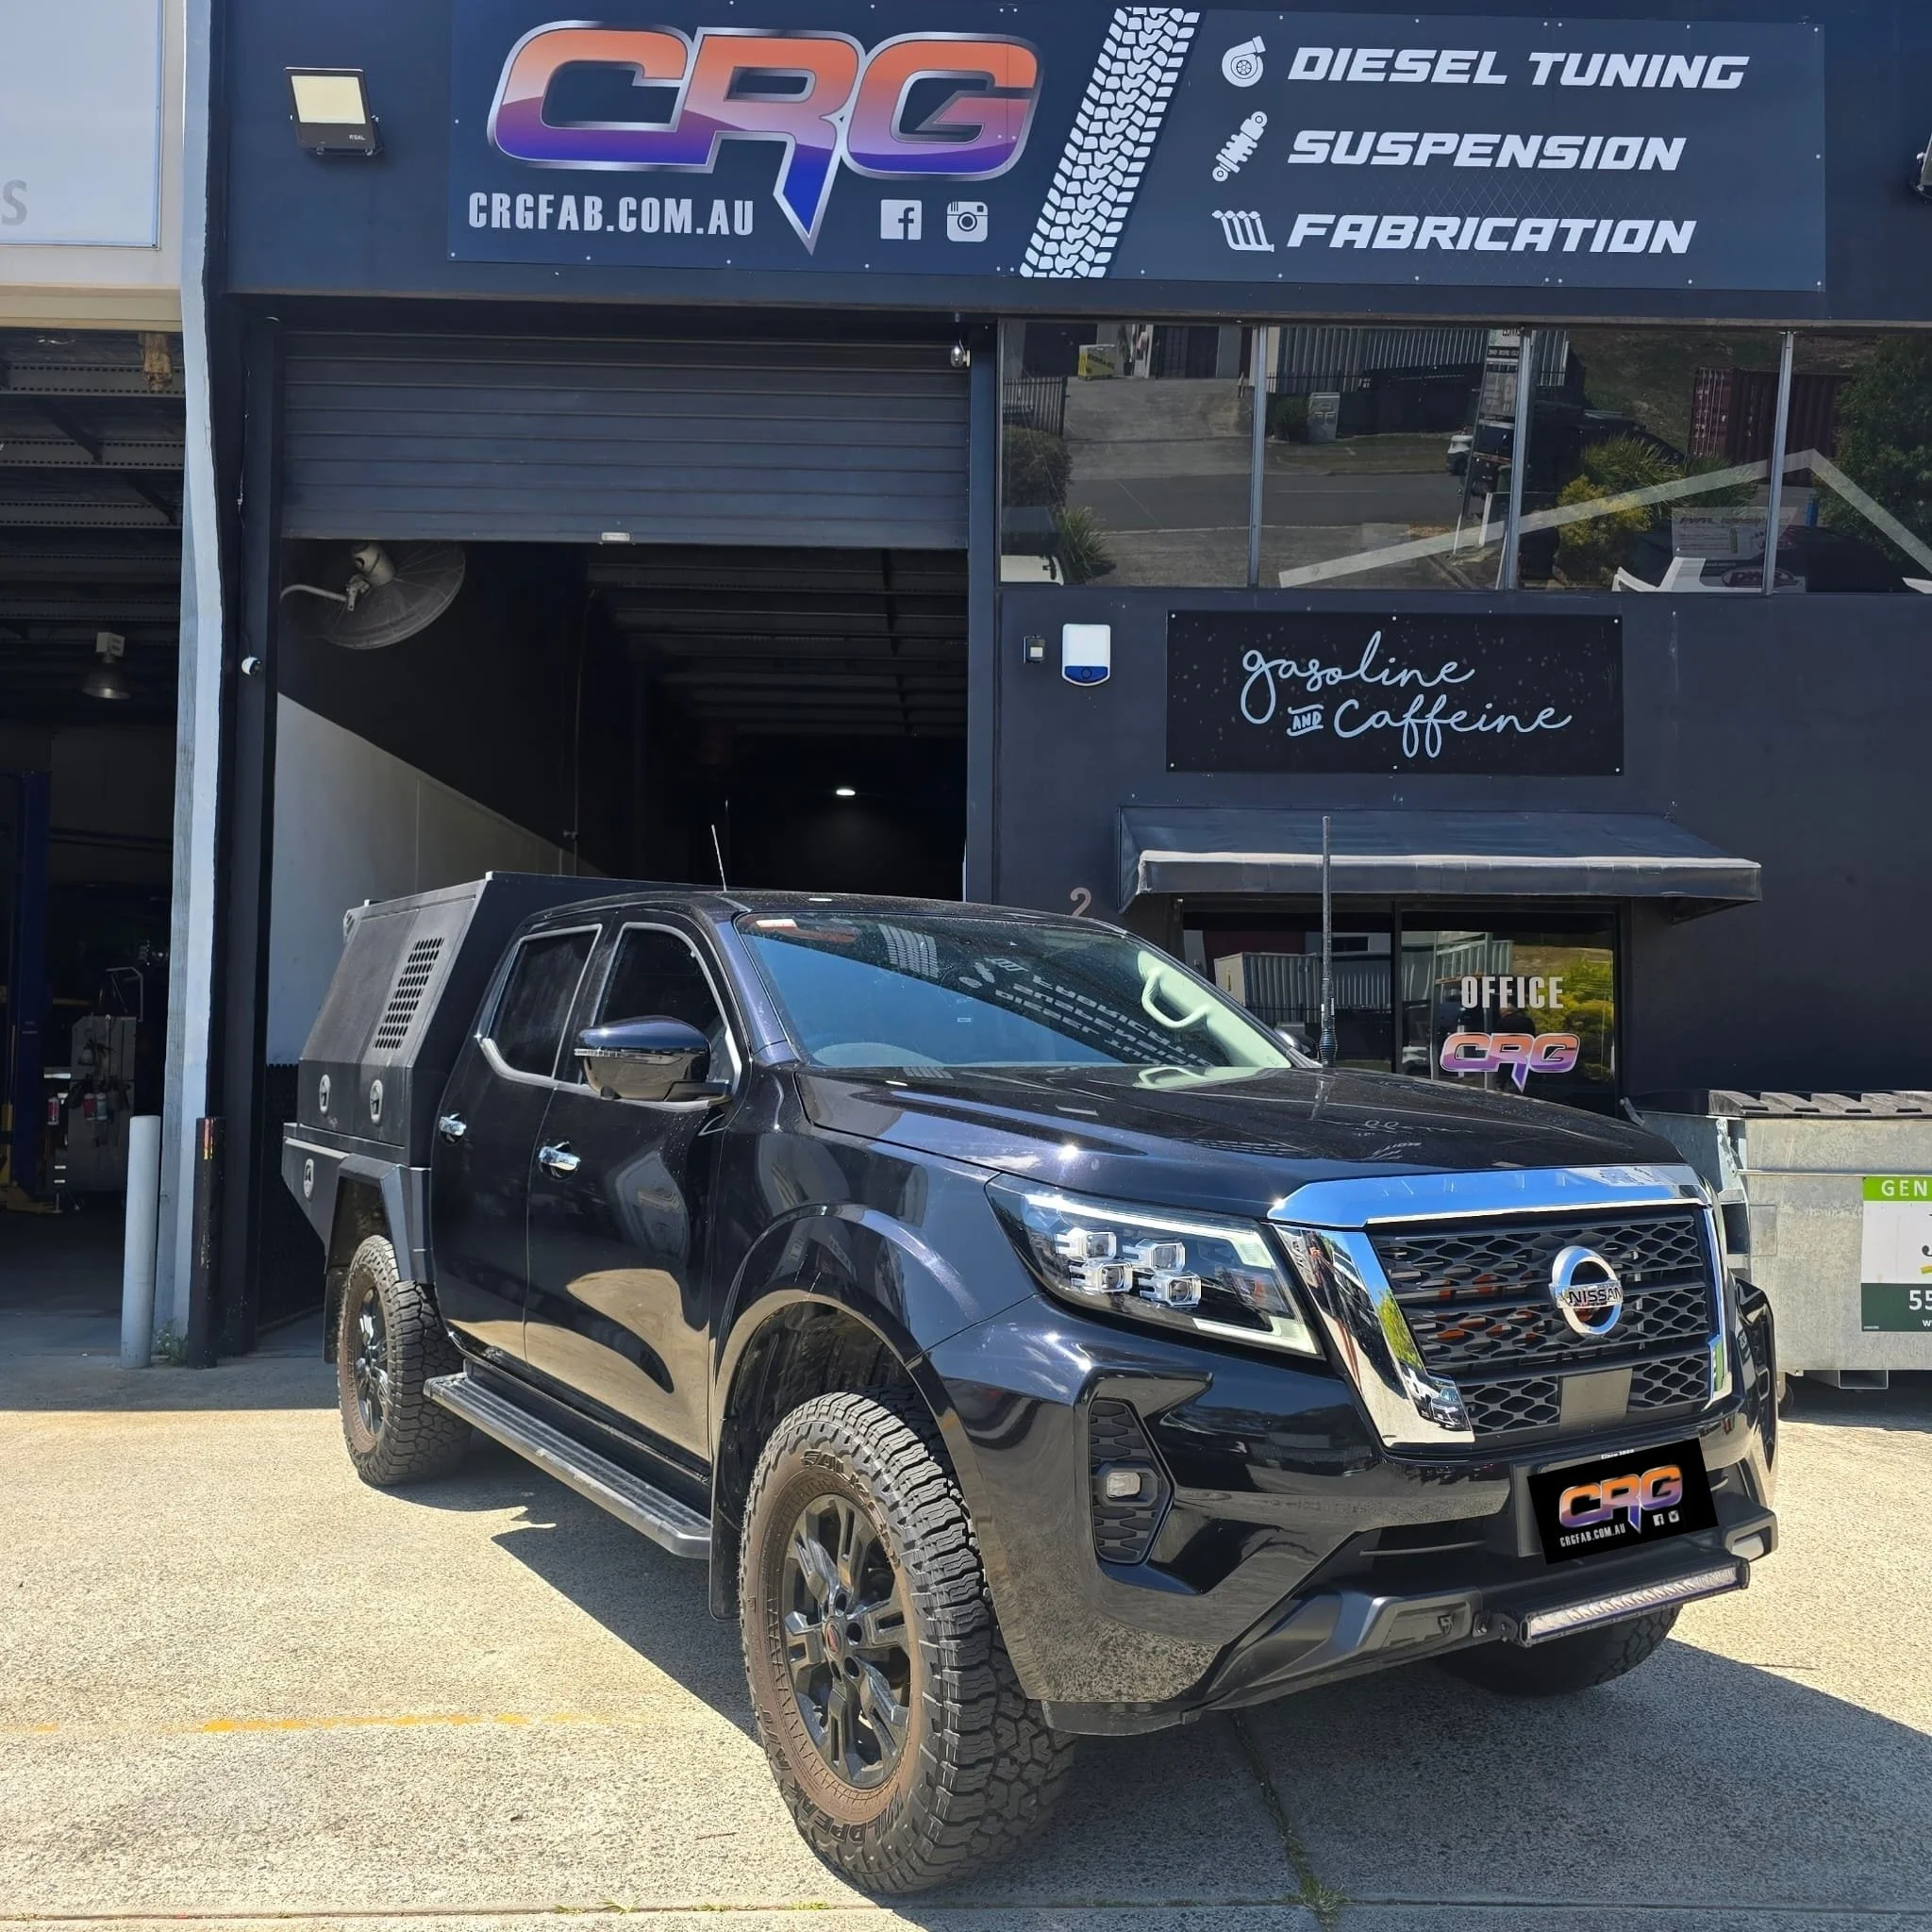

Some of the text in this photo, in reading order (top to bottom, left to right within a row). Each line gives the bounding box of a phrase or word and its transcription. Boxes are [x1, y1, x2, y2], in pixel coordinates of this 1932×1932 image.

[1287, 46, 1751, 90] DIESEL TUNING
[486, 20, 1041, 256] CRG
[1287, 129, 1687, 172] SUSPENSION
[468, 192, 754, 236] CRGFAB.COM.AU
[1287, 213, 1698, 255] FABRICATION
[1241, 630, 1475, 724] gasoline
[1290, 709, 1323, 732] AND
[1461, 976, 1564, 1008] OFFICE
[1440, 1032, 1580, 1094] CRG
[1568, 1286, 1623, 1304] NISSAN
